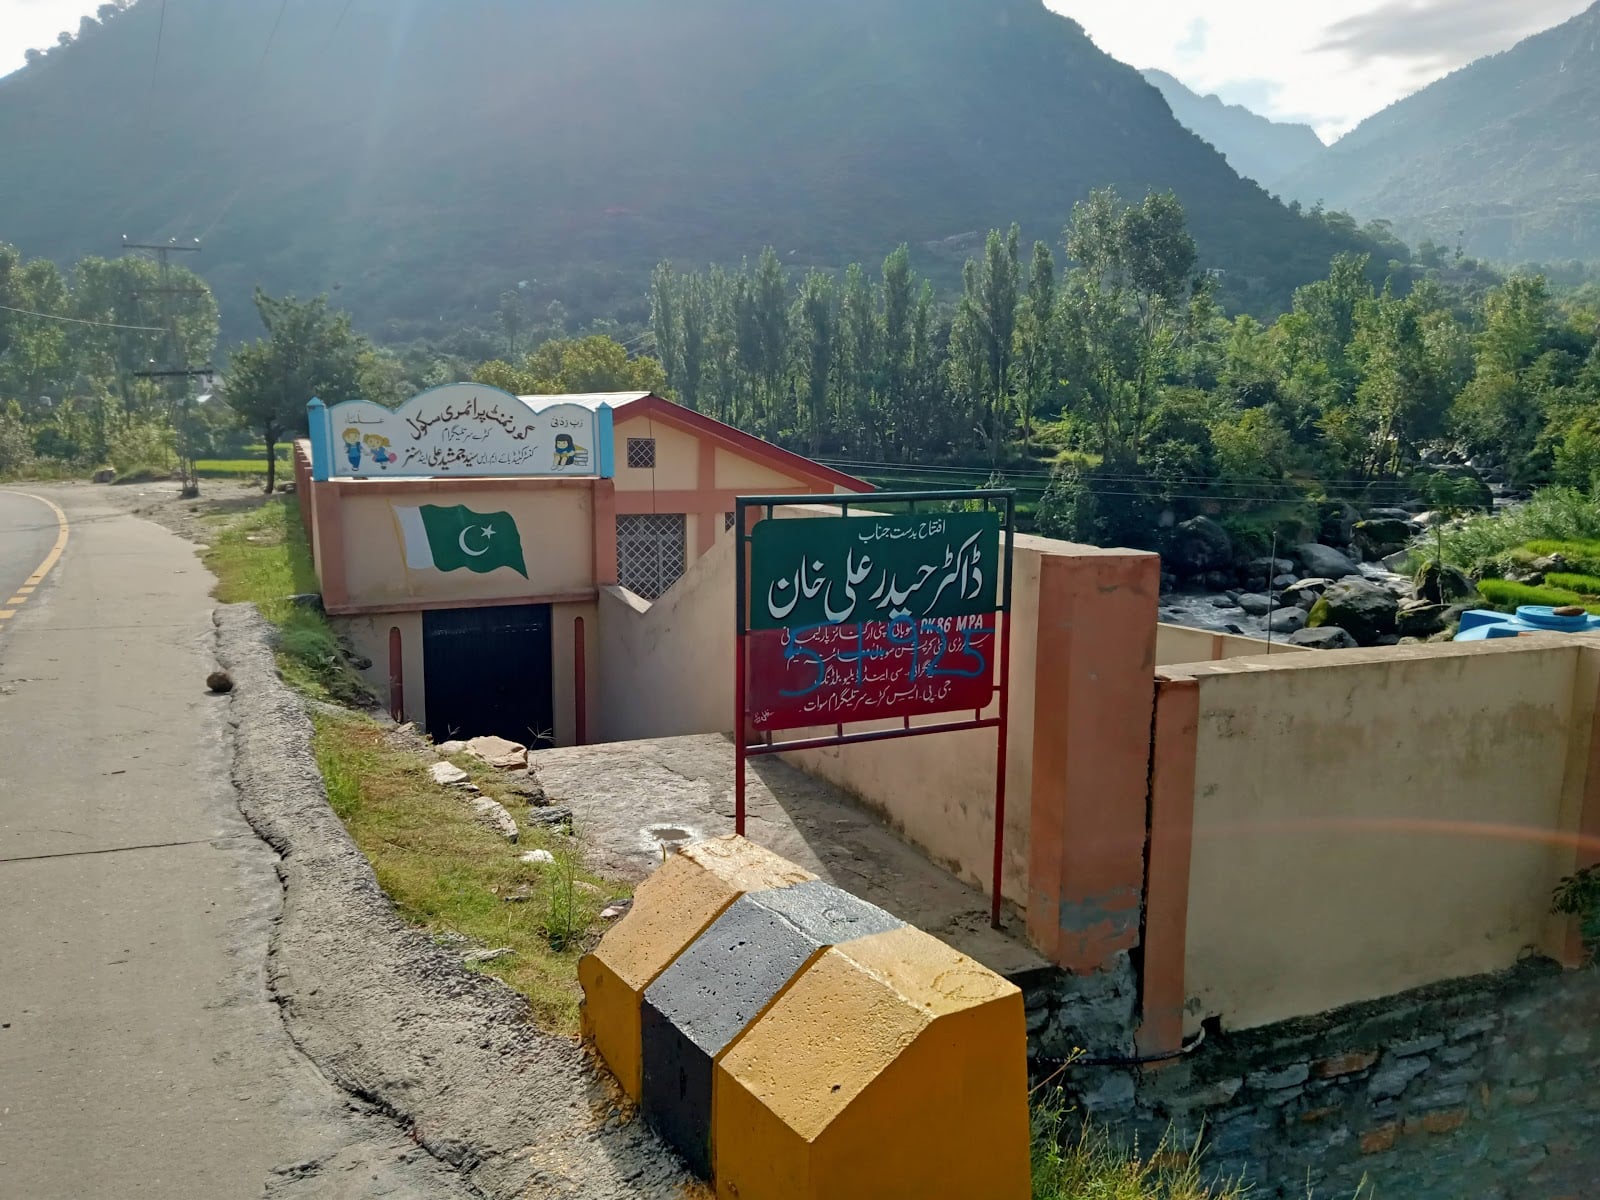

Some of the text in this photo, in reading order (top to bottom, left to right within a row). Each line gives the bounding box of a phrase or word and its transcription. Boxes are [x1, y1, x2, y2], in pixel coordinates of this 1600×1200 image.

[405, 409, 441, 440] سکول
[858, 522, 890, 544] جناب
[767, 528, 984, 624] ڈاکٹر حیدر علی خان
[956, 614, 984, 632] MPA
